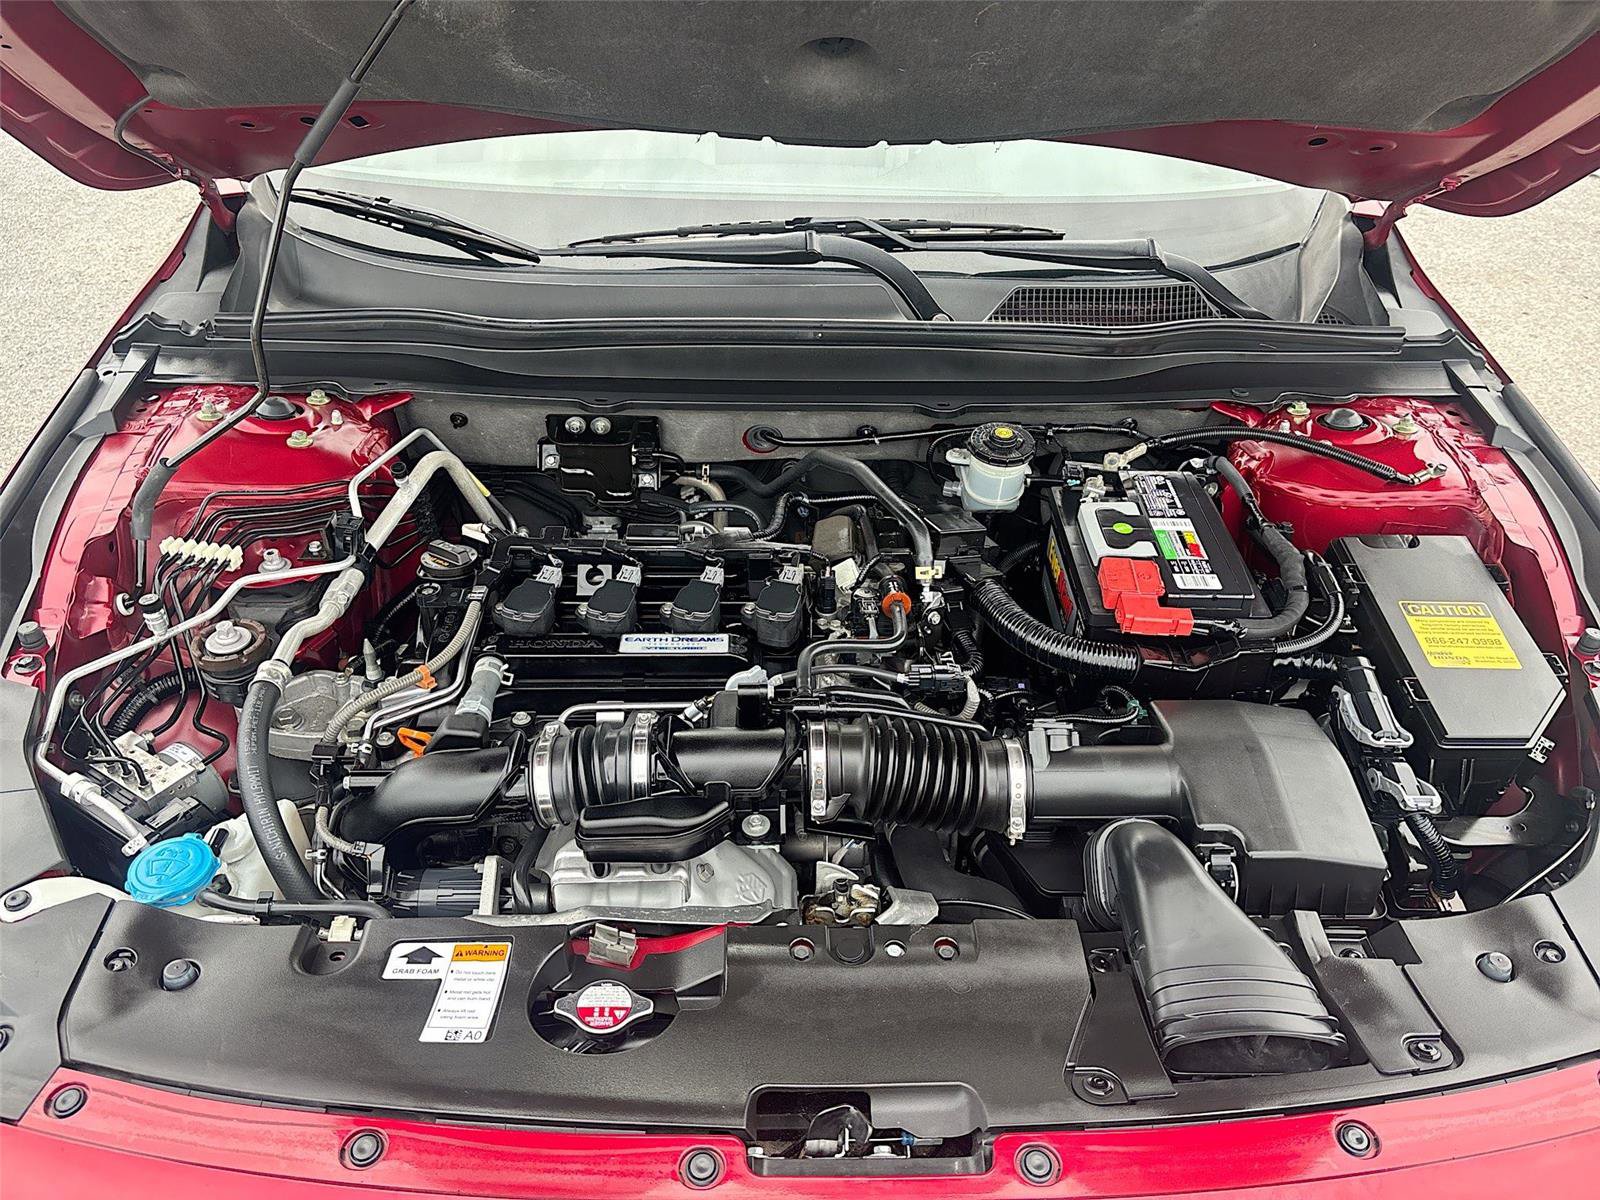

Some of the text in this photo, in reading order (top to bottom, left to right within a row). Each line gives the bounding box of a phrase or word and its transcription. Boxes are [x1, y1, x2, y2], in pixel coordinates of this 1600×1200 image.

[1408, 604, 1485, 615] CAUTION
[508, 639, 604, 649] HONDA
[465, 949, 505, 957] WARNING
